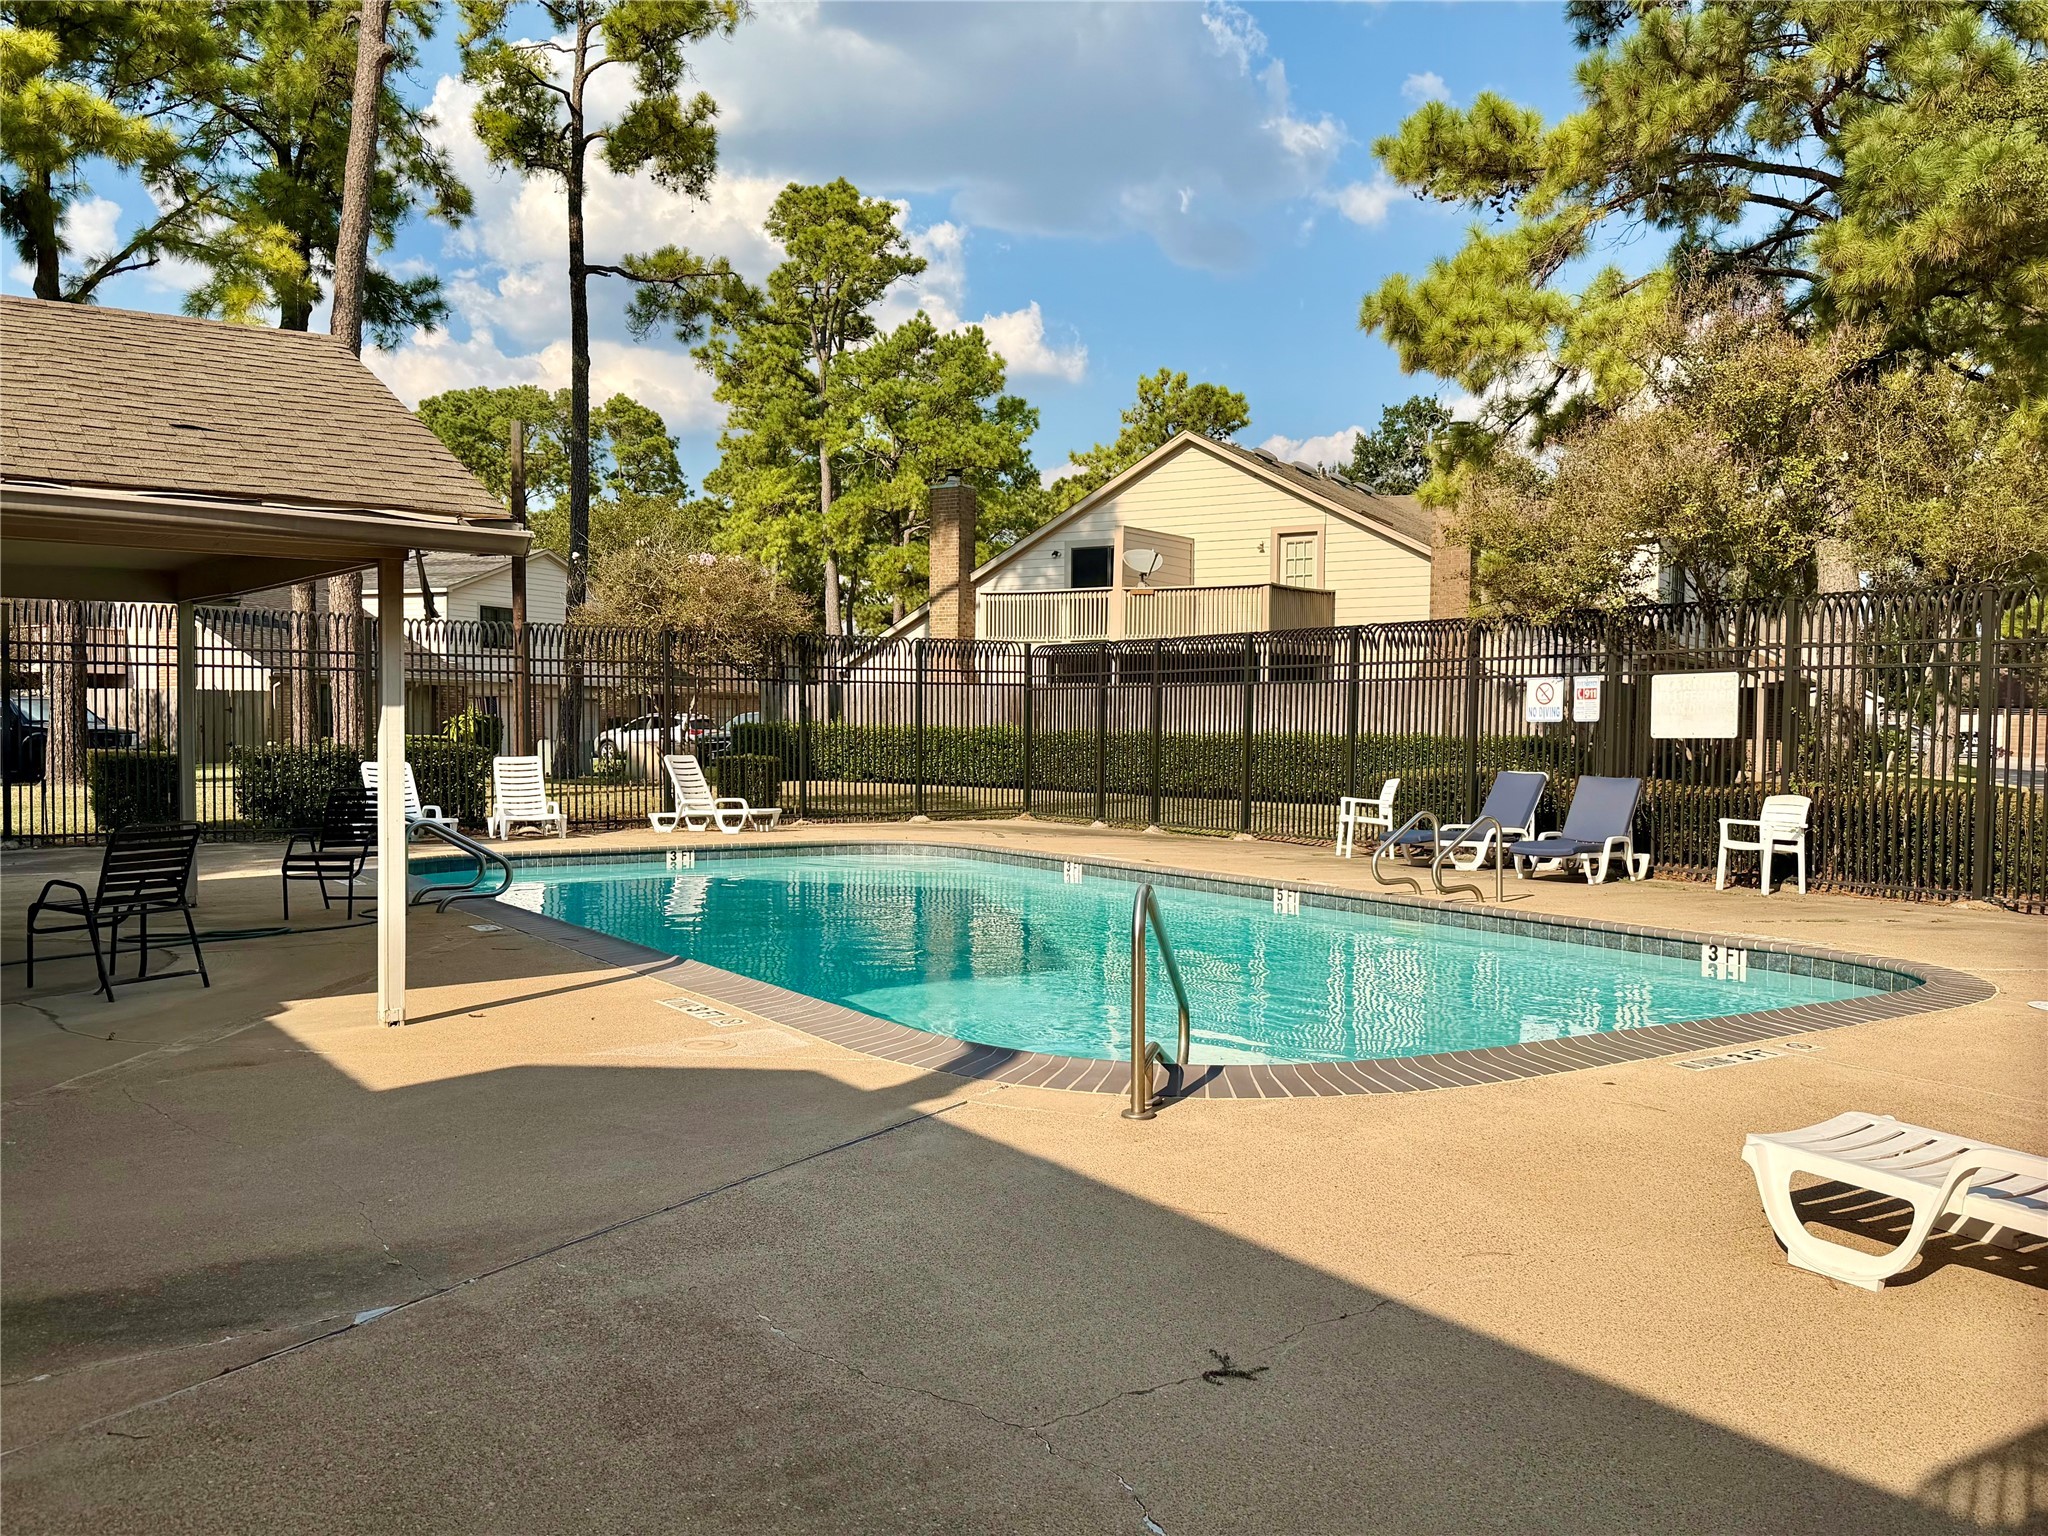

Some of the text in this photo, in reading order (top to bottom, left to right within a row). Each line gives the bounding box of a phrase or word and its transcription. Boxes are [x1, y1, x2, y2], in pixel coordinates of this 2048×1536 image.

[1584, 689, 1597, 699] 911
[1528, 707, 1560, 718] NO DIVING
[670, 850, 693, 861] 3 FT
[1708, 944, 1744, 965] 3 FT
[1727, 1049, 1779, 1061] 3 FT
